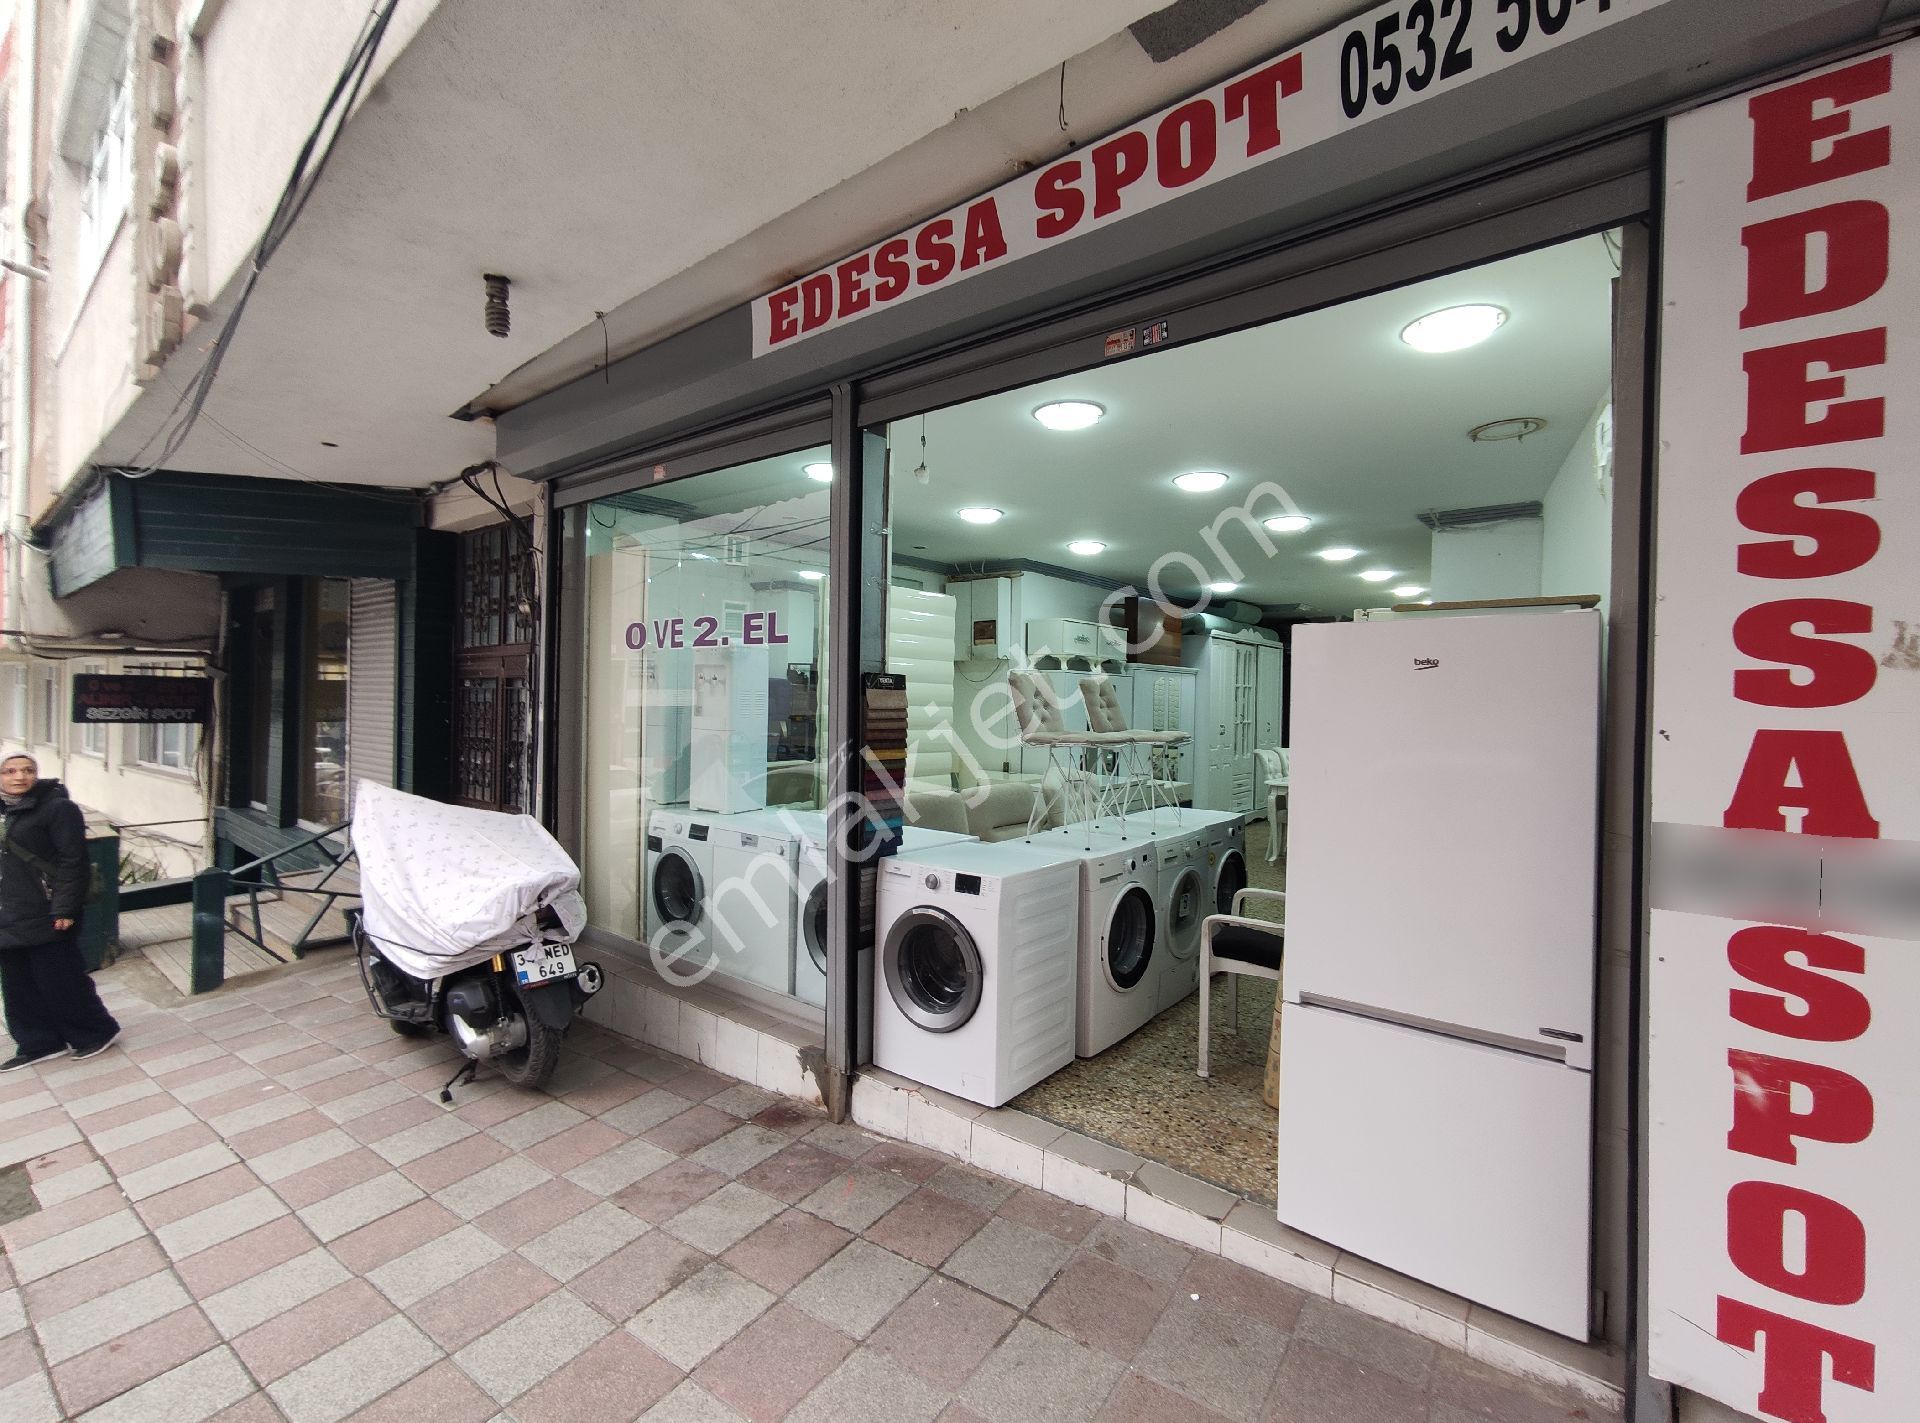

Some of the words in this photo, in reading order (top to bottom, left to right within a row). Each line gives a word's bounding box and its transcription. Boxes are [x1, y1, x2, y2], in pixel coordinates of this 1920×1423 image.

[767, 196, 1008, 345] EDESSA
[1034, 57, 1303, 239] SPOT
[1340, 0, 1473, 119] 0532
[1723, 53, 1893, 840] EDESSA
[653, 618, 684, 649] VE
[692, 616, 729, 648] 2.
[743, 611, 789, 645] EL
[1413, 657, 1440, 668] beko
[152, 707, 196, 720] SPOT
[543, 944, 570, 960] NED
[538, 962, 565, 978] 649
[1716, 925, 1876, 1423] SPOT
